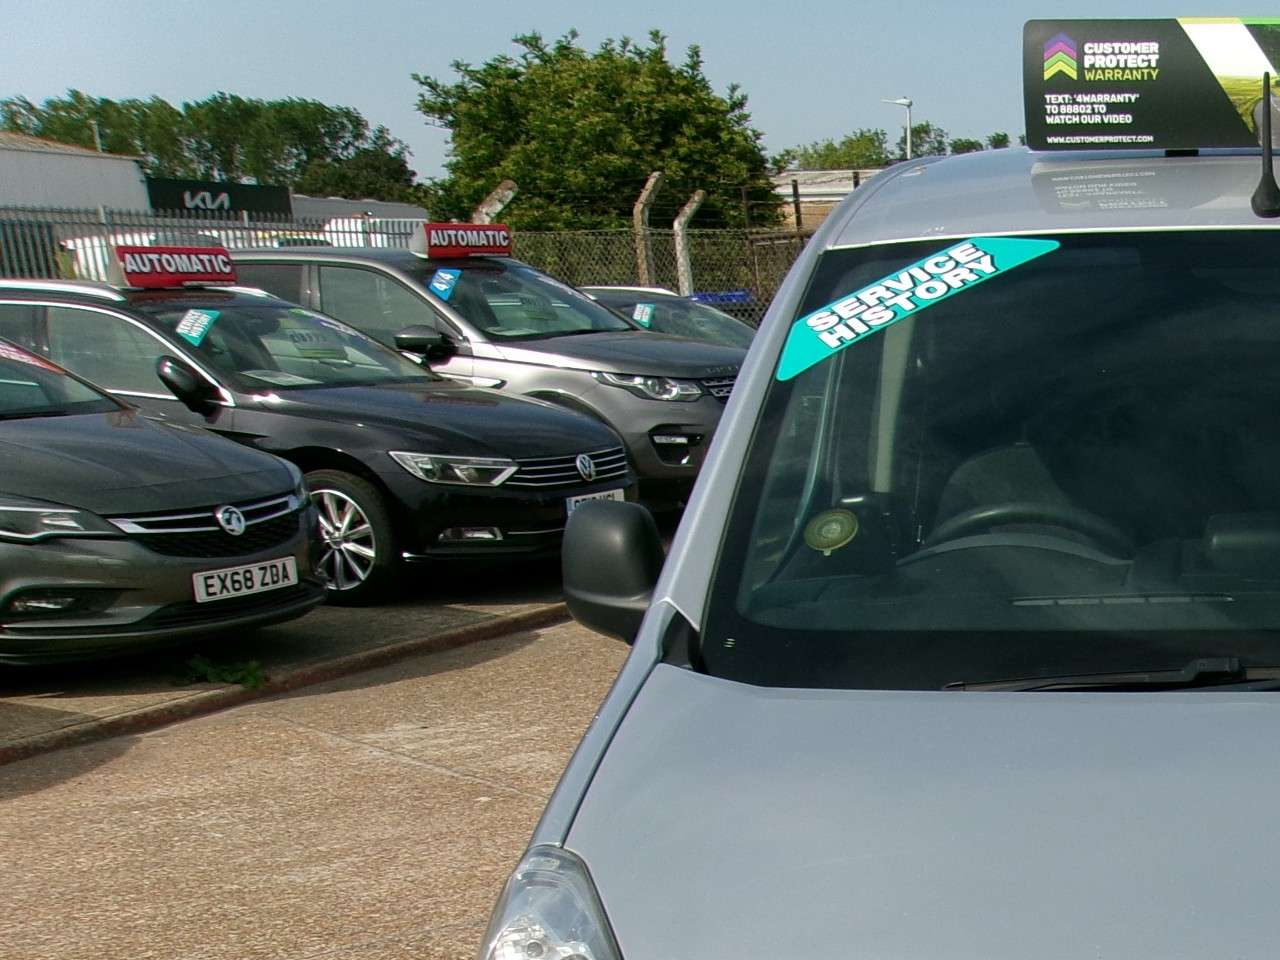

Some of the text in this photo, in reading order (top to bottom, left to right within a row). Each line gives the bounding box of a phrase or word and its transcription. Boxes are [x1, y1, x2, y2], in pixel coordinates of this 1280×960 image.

[1084, 42, 1159, 54] CUSTOMER
[1084, 55, 1159, 68] PROTECT
[1084, 69, 1159, 81] WARRANTY
[1044, 94, 1072, 104] TEXT:
[1045, 105, 1059, 114] TO
[1093, 104, 1107, 113] TO
[1045, 114, 1133, 124] WATCH OUR VIDEO
[430, 229, 509, 247] AUTOMATIC
[124, 253, 232, 273] AUTOMATIC
[806, 242, 986, 332] SERVICE
[817, 253, 998, 349] HISTORY
[203, 569, 255, 597] EX68
